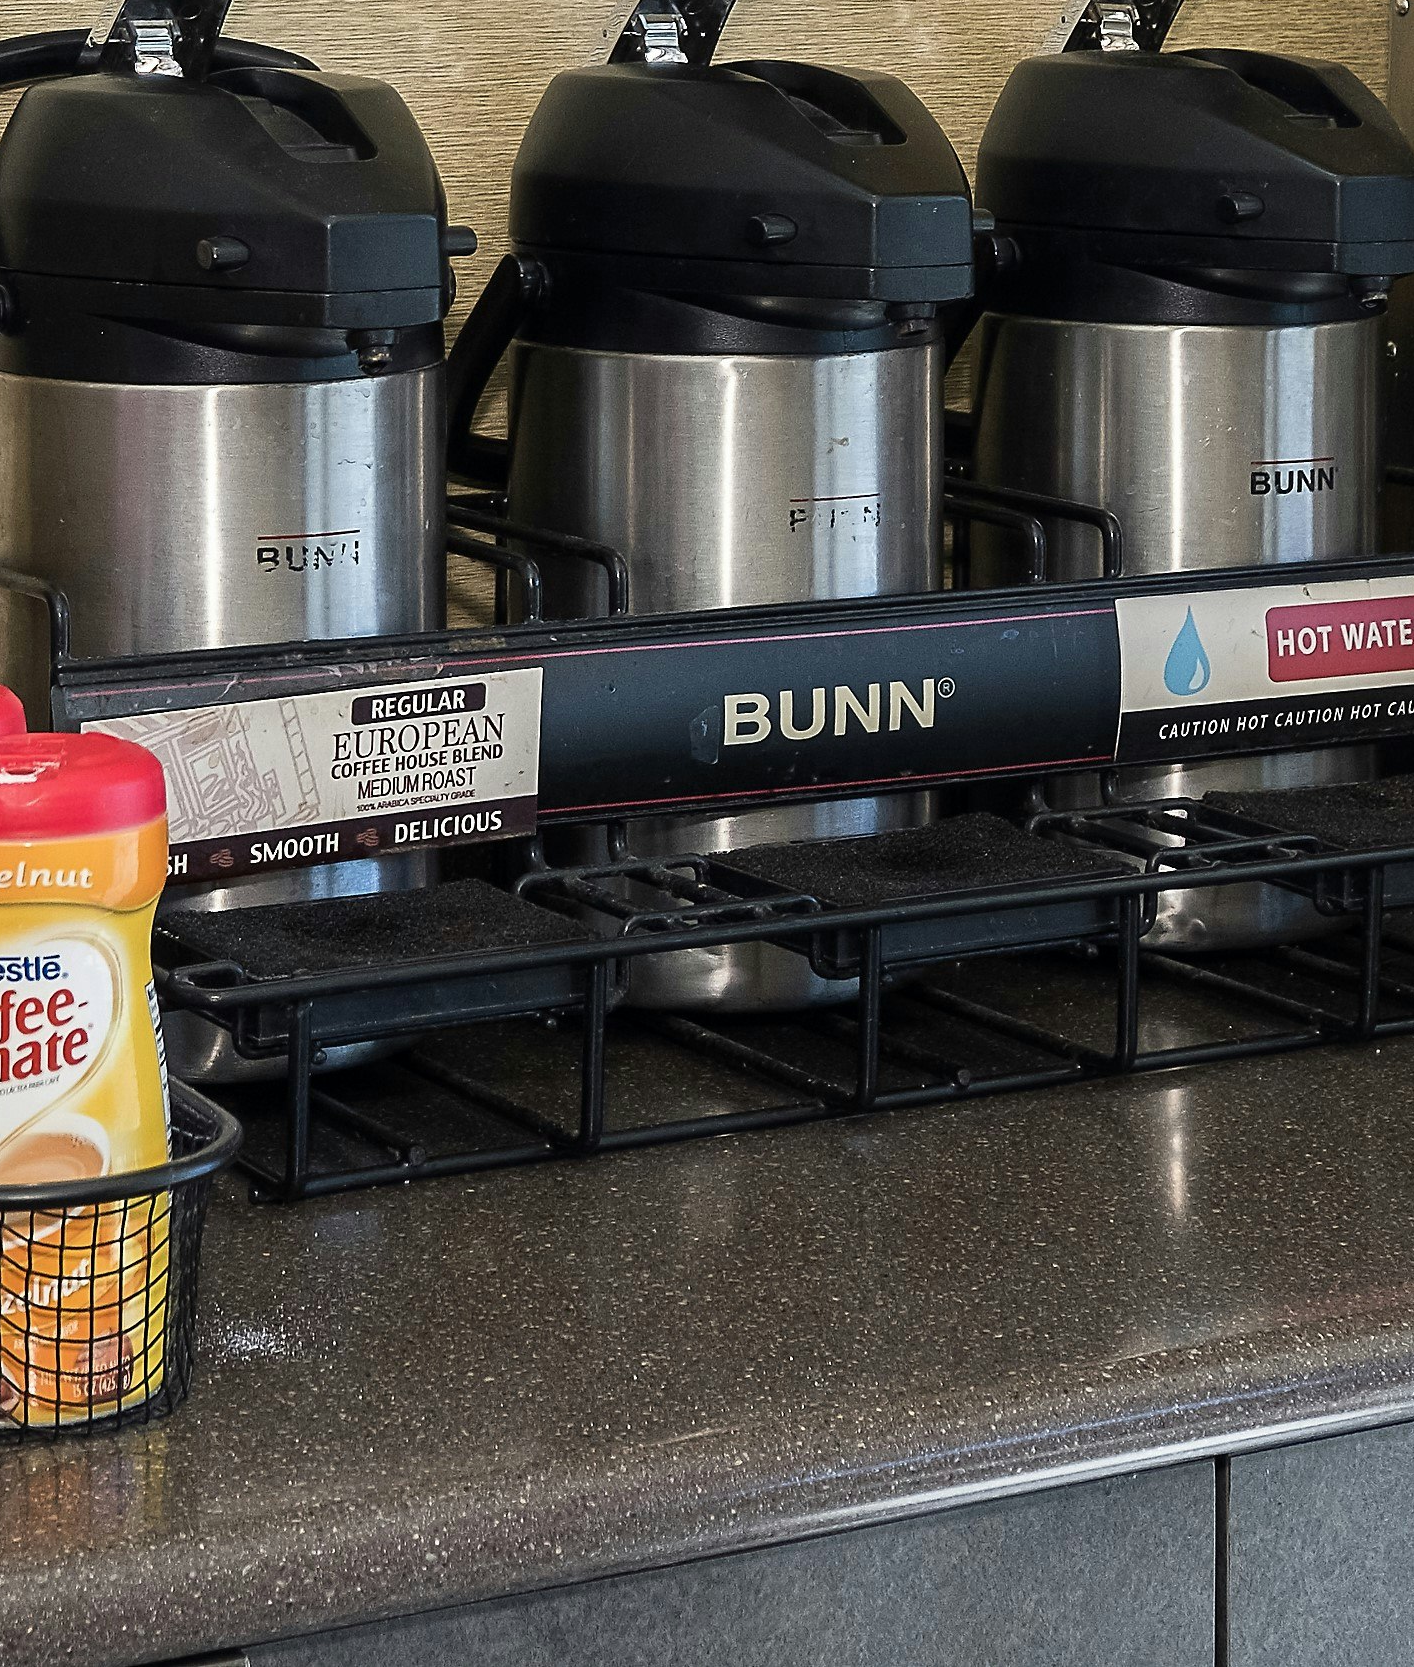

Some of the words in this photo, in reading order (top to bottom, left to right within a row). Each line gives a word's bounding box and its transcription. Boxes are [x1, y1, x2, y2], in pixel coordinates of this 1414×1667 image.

[1251, 467, 1334, 495] BUNN
[1277, 625, 1333, 658] HOT
[371, 689, 466, 720] REGULAR
[1159, 717, 1230, 741] CAUTION
[1236, 713, 1269, 734] HOT
[1274, 706, 1344, 728] CAUTION
[1349, 702, 1382, 720] HOT
[332, 713, 505, 762] EUROPEAN
[331, 757, 391, 780] COFFEE
[395, 750, 448, 772] HOUSE
[452, 743, 504, 764] BLEND
[357, 774, 419, 800] MEDIUM
[422, 766, 476, 792] ROAST
[356, 803, 376, 813] 100%
[376, 799, 410, 810] ARABICA
[410, 793, 450, 807] SPECIALTY
[450, 789, 476, 800] GRADE
[249, 833, 340, 864] SMOOTH
[394, 810, 502, 844] DELICIOUS
